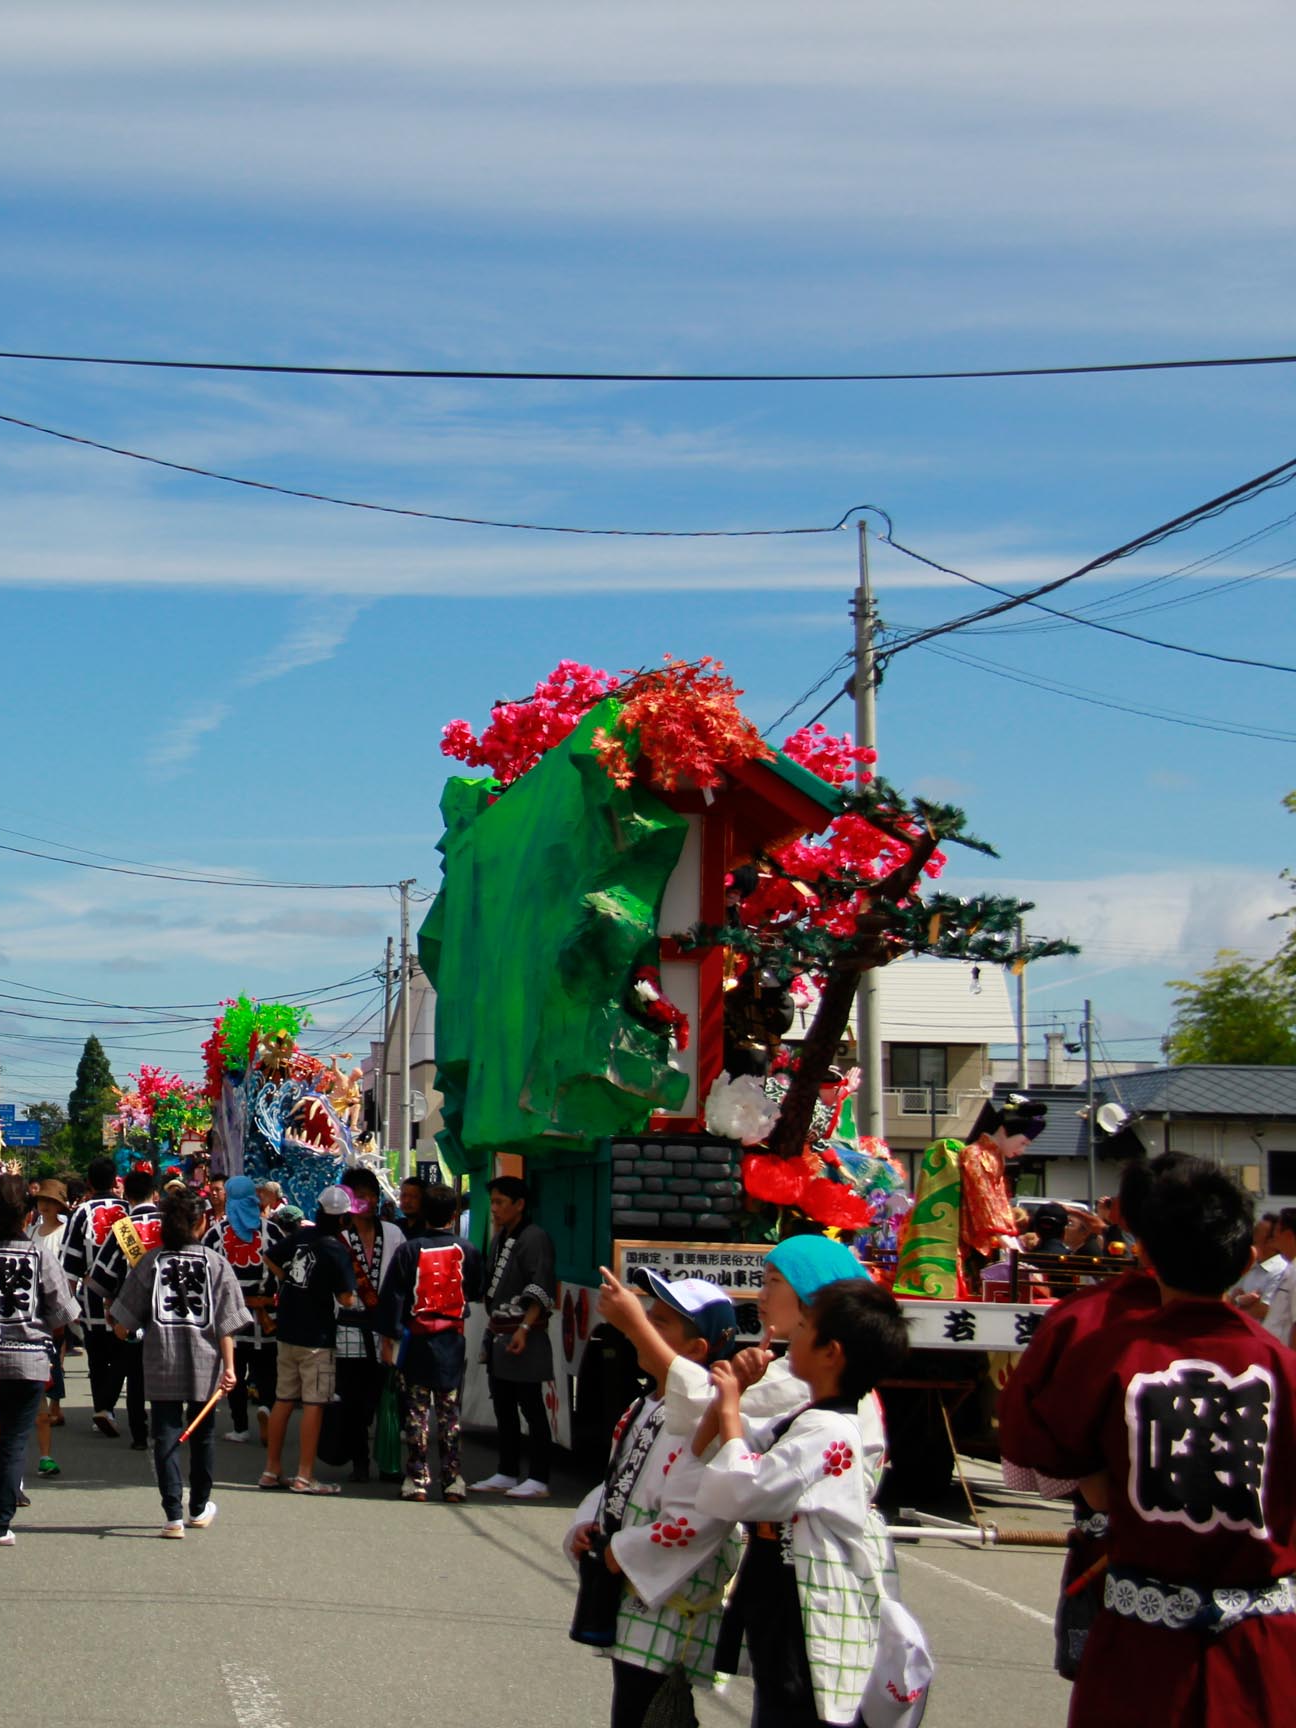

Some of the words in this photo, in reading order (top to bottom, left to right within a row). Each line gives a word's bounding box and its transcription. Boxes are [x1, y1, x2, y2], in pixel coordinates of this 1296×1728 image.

[626, 1265, 764, 1289] まつりの山車行
